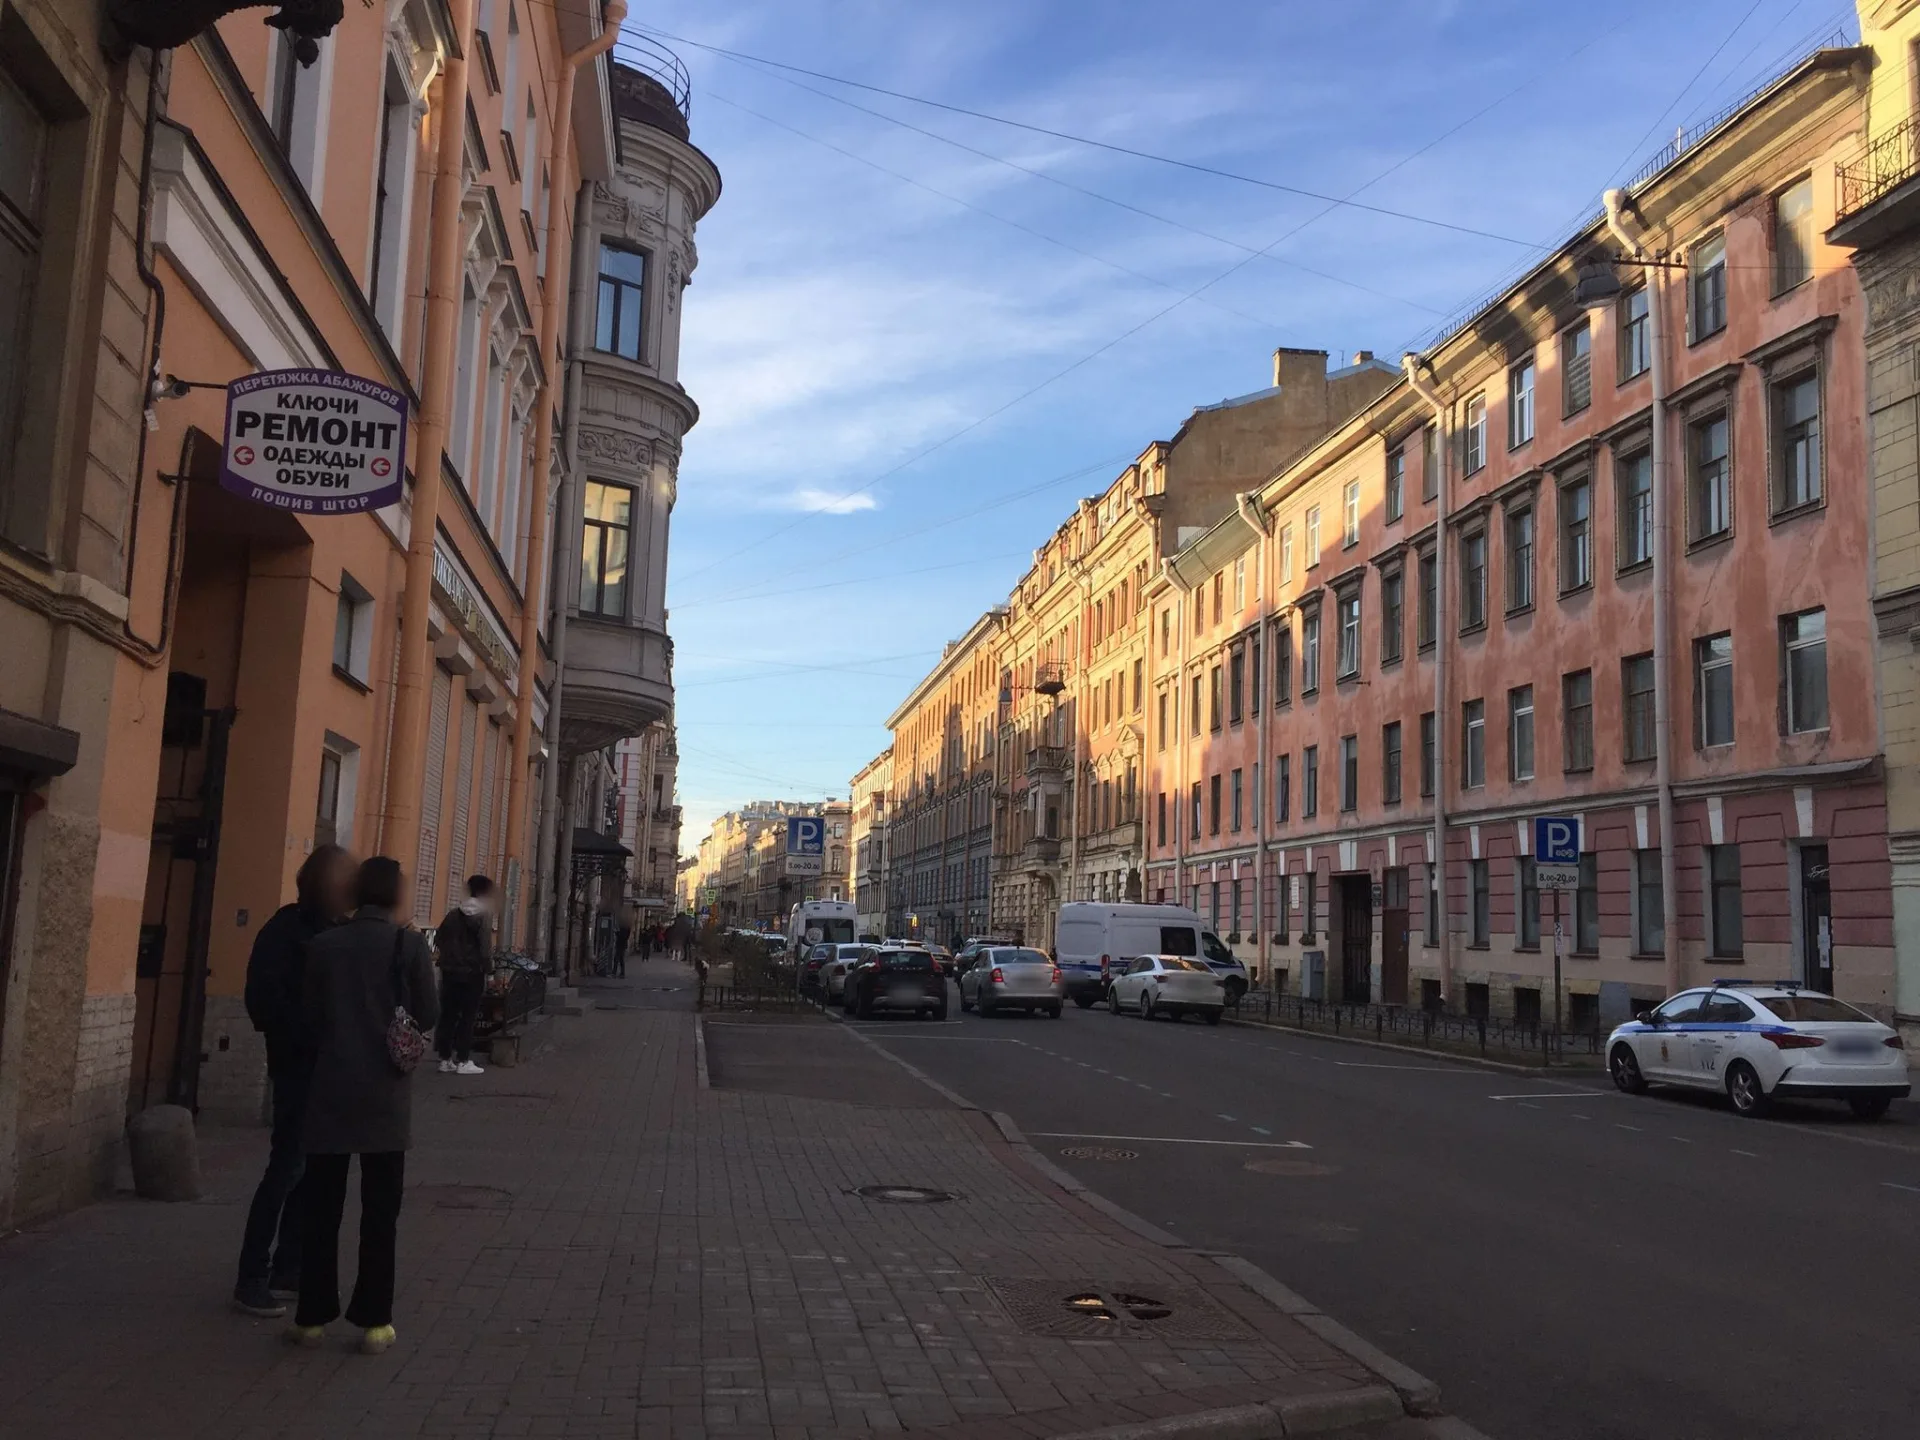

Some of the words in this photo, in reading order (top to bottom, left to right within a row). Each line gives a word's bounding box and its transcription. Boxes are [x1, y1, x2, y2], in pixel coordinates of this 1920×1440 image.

[233, 372, 319, 395] ПЕРЕТЯЖКА
[323, 374, 400, 406] АБАЖУРОВ
[277, 392, 359, 414] КЛЮЧИ
[235, 410, 397, 450] РЕМОНТ
[263, 446, 365, 470] ОДЕЖДЫ
[276, 468, 350, 489] ОБУВИ
[251, 487, 313, 510] ПОШИВ
[322, 496, 369, 511] ШТОР
[797, 821, 818, 850] P
[1547, 822, 1571, 858] P
[1539, 873, 1577, 883] 8.00-20.00
